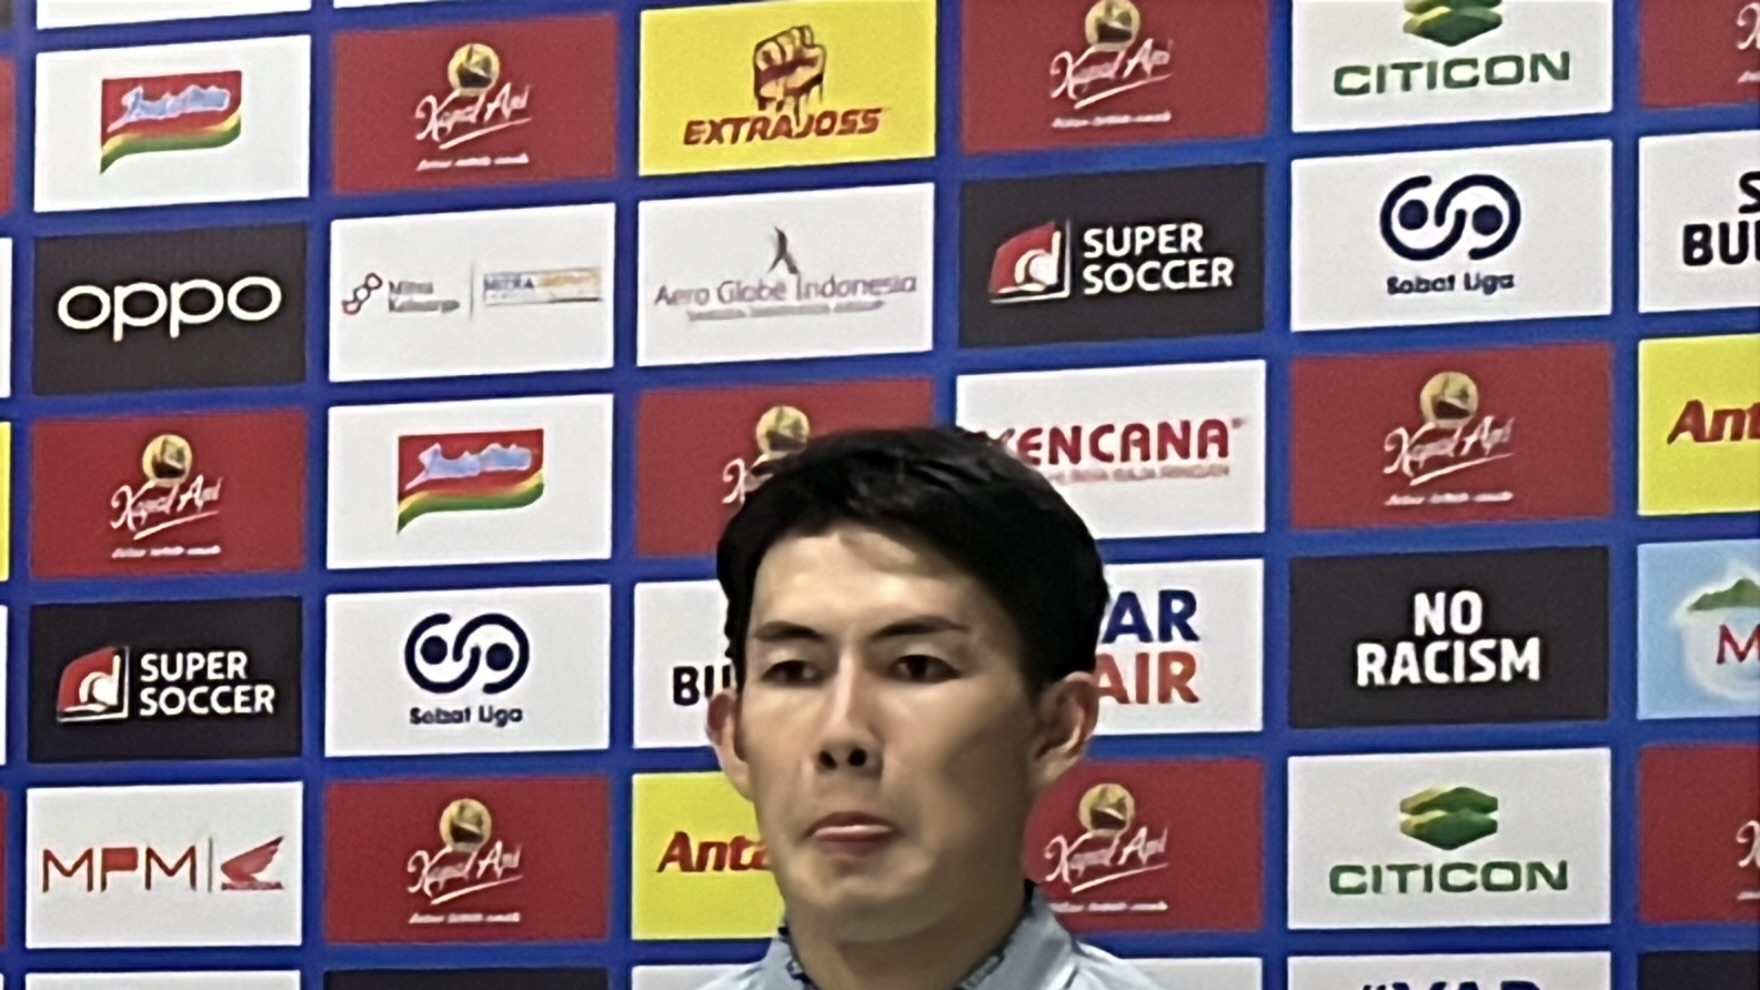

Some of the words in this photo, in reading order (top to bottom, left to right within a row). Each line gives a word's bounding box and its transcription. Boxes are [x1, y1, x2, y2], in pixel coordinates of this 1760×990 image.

[1334, 51, 1571, 97] CITICON
[683, 108, 882, 146] EXTRAJOSS
[1083, 222, 1203, 259] SUPER
[1083, 259, 1234, 296] SOCCER
[57, 275, 282, 342] oppo
[1102, 589, 1200, 643] AR
[1414, 589, 1482, 636] NO
[139, 650, 247, 682] SUPER
[1096, 651, 1200, 705] AIR
[1356, 636, 1541, 686] RACISM
[139, 683, 275, 718] SOCCER
[42, 845, 197, 893] MPM
[1328, 860, 1569, 896] CITICON
